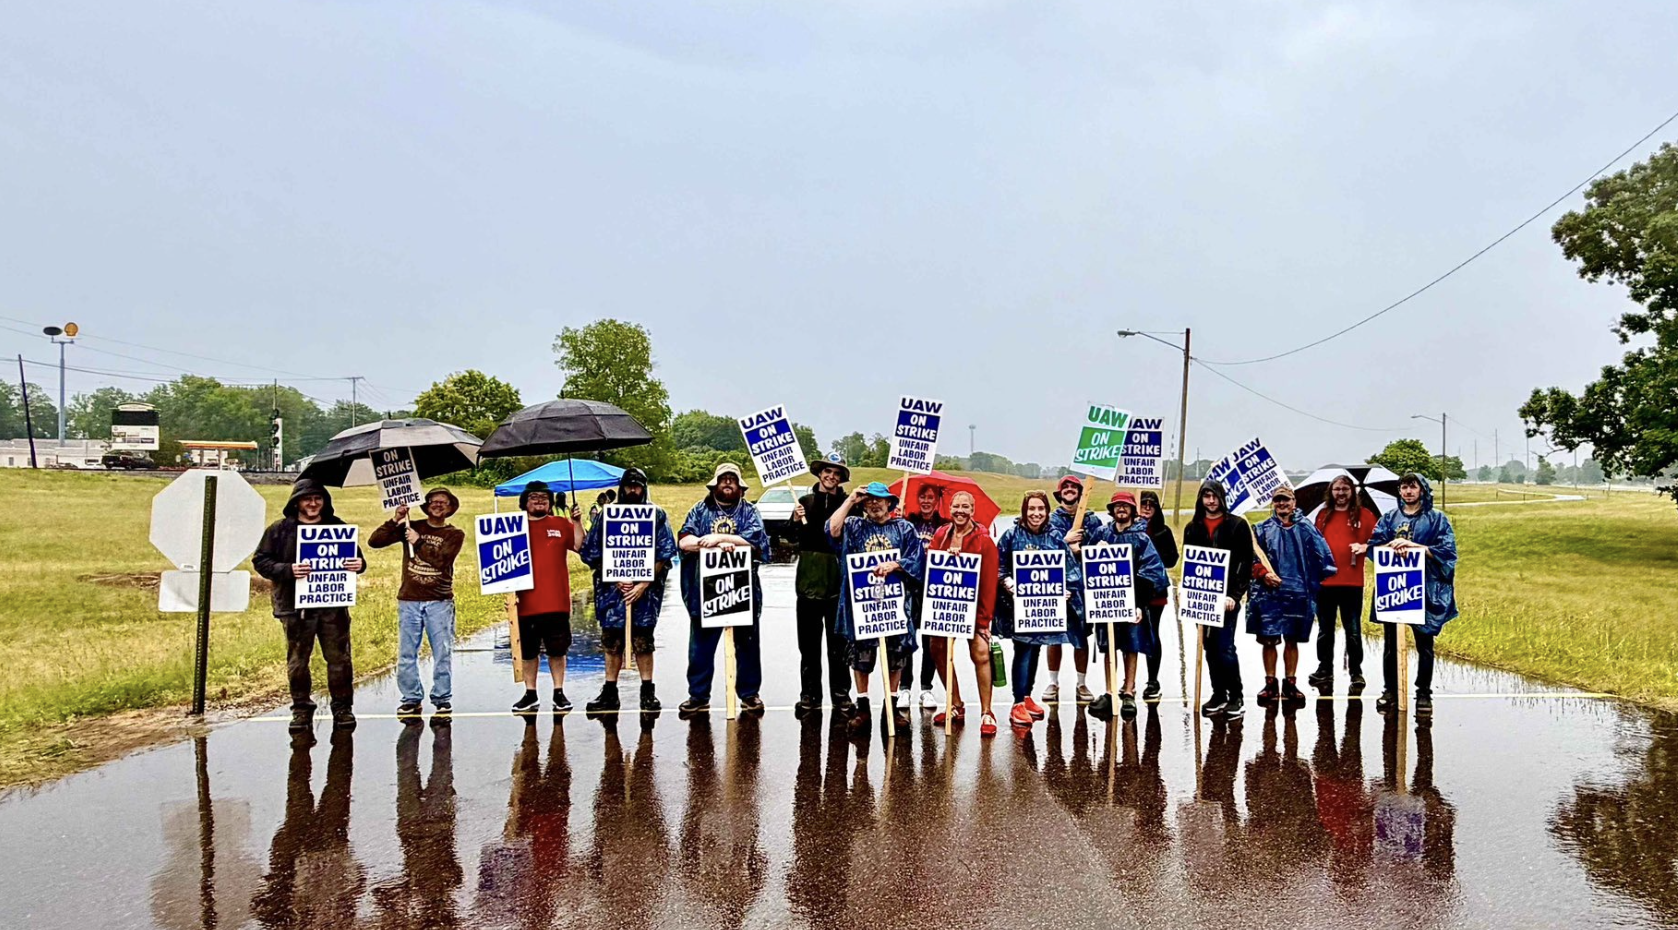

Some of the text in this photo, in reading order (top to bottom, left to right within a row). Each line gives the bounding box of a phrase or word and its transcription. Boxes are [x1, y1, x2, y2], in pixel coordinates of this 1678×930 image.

[901, 397, 943, 414] UAW
[741, 407, 782, 430] UAW
[910, 414, 927, 426] ON
[1087, 405, 1129, 429] UAW
[1128, 418, 1163, 430] AW
[759, 424, 777, 439] ON
[897, 424, 937, 440] STRIKE
[751, 431, 793, 454] STRIKE
[899, 439, 929, 451] UNFAIR
[1091, 431, 1110, 446] ON
[1132, 433, 1149, 444] ON
[383, 449, 398, 462] ON
[761, 446, 793, 463] UNFAIR
[898, 448, 926, 461] LABOR
[1075, 444, 1121, 462] STRIKE
[766, 455, 795, 472] LABOR
[891, 456, 931, 471] PRACTICE
[1124, 458, 1156, 467] UNFAIR
[1245, 454, 1260, 468] ON
[376, 459, 412, 477] STRIKE
[762, 461, 806, 483] PRACTICE
[1125, 467, 1154, 475] LABOR
[383, 475, 411, 488] UNFAIR
[1118, 475, 1160, 485] PRACTICE
[1221, 478, 1230, 493] N
[1251, 470, 1277, 490] UNFAIR
[1257, 477, 1281, 496] LABOR
[387, 485, 412, 497] LABOR
[1225, 479, 1245, 509] RIKE
[383, 492, 420, 509] PRACTICE
[607, 507, 654, 519] UAW
[479, 515, 523, 535] UAW
[620, 523, 639, 534] ON
[301, 528, 356, 540] UAW
[607, 535, 652, 547] STRIKE
[317, 544, 339, 556] ON
[493, 539, 512, 560] ON
[612, 550, 647, 559] UNFAIR
[1085, 547, 1129, 560] UAW
[1186, 548, 1227, 564] UAW
[302, 557, 348, 569] TRIK
[482, 549, 530, 583] STRIKE
[614, 559, 645, 568] LABOR
[705, 551, 747, 569] UAW
[930, 553, 979, 569] UAW
[1016, 554, 1063, 566] UAW
[1378, 551, 1421, 568] UAW
[606, 569, 652, 578] PRACTICE
[1099, 562, 1117, 574] ON
[1195, 565, 1212, 577] ON
[307, 573, 347, 583] UNFAIR
[943, 571, 962, 585] ON
[1030, 570, 1049, 582] ON
[1088, 575, 1131, 588] STRIKE
[1388, 573, 1407, 591] ON
[308, 583, 345, 593] LABOR
[715, 573, 735, 595] ON
[1018, 582, 1062, 595] STRIKE
[1183, 575, 1224, 592] STRIKE
[299, 593, 353, 604] PRACTICE
[928, 584, 975, 600] STRIKE
[1093, 590, 1127, 599] UNFAIR
[1187, 590, 1218, 603] UNFAIR
[1377, 585, 1423, 611] STRIKE
[703, 585, 750, 617] STRIKE
[862, 600, 898, 613] UNFAIR
[932, 600, 968, 613] UNFAIR
[1023, 598, 1058, 608] UNFAIR
[1095, 599, 1126, 609] LABOR
[1187, 600, 1215, 612] LABOR
[865, 611, 897, 623] LABOR
[933, 611, 966, 623] LABOR
[1025, 608, 1057, 618] LABOR
[1089, 608, 1133, 619] PRACTICE
[1181, 608, 1221, 623] PRACTICE
[858, 620, 906, 635] PRACTICE
[924, 621, 972, 634] PRACTICE
[1018, 618, 1064, 628] PRACTICE
